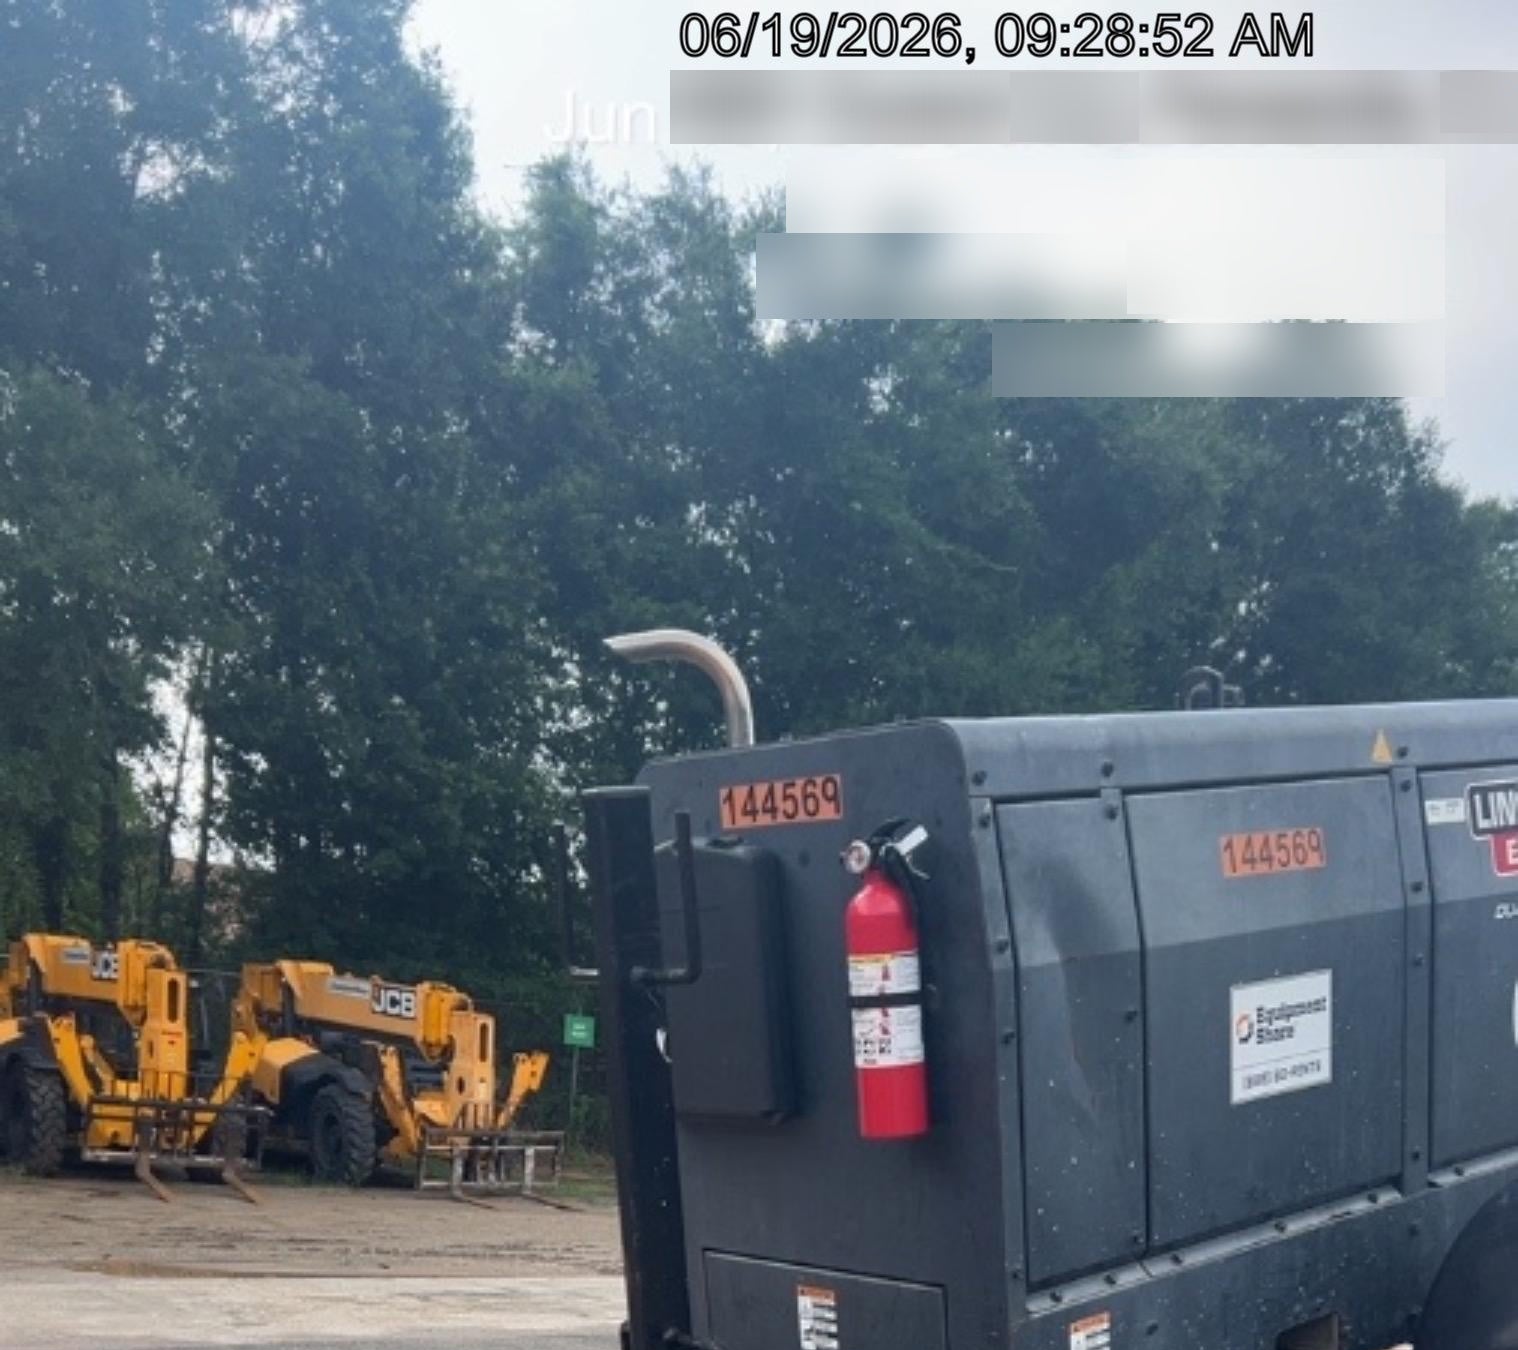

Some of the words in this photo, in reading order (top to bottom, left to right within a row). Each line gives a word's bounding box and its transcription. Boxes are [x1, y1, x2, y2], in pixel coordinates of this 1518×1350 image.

[722, 776, 841, 826] 144569
[1473, 789, 1518, 829] LIN
[1223, 829, 1325, 874] 144569
[371, 986, 417, 1019] JCB
